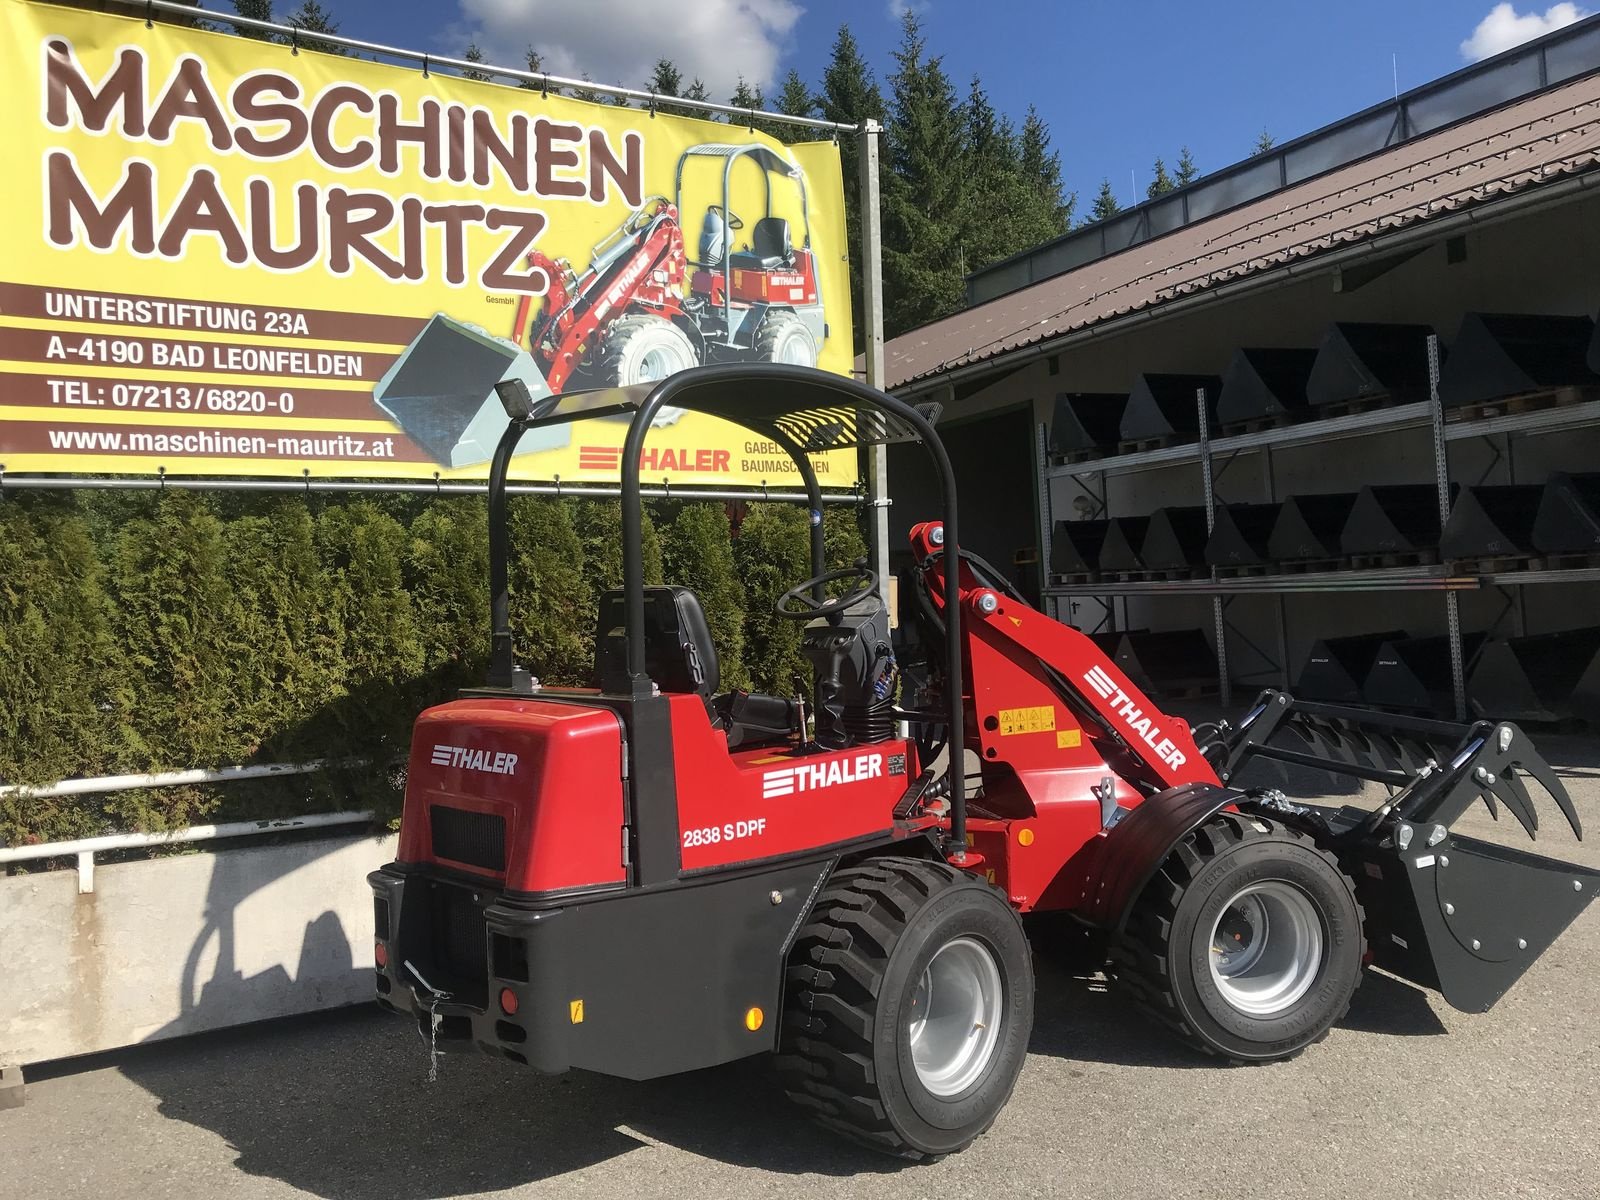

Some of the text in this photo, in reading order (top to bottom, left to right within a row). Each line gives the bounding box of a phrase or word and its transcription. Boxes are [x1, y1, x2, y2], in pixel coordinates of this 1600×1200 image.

[46, 39, 642, 206] MASCHINEN
[49, 152, 547, 291] MAURITZ
[45, 292, 309, 335] UNTERSTIFTUNG 23A
[485, 295, 515, 305] GesmbH
[46, 335, 362, 377] A-4190 BAD LEONFELDEN
[47, 380, 294, 414] TEL: 07213/6820-0
[49, 430, 394, 458] www.maschinen-mauritz.at
[619, 447, 731, 472] HALER
[1108, 689, 1187, 772] THALER
[452, 746, 519, 775] THALER
[794, 753, 882, 792] THALER
[683, 818, 766, 848] 2838 S DPF
